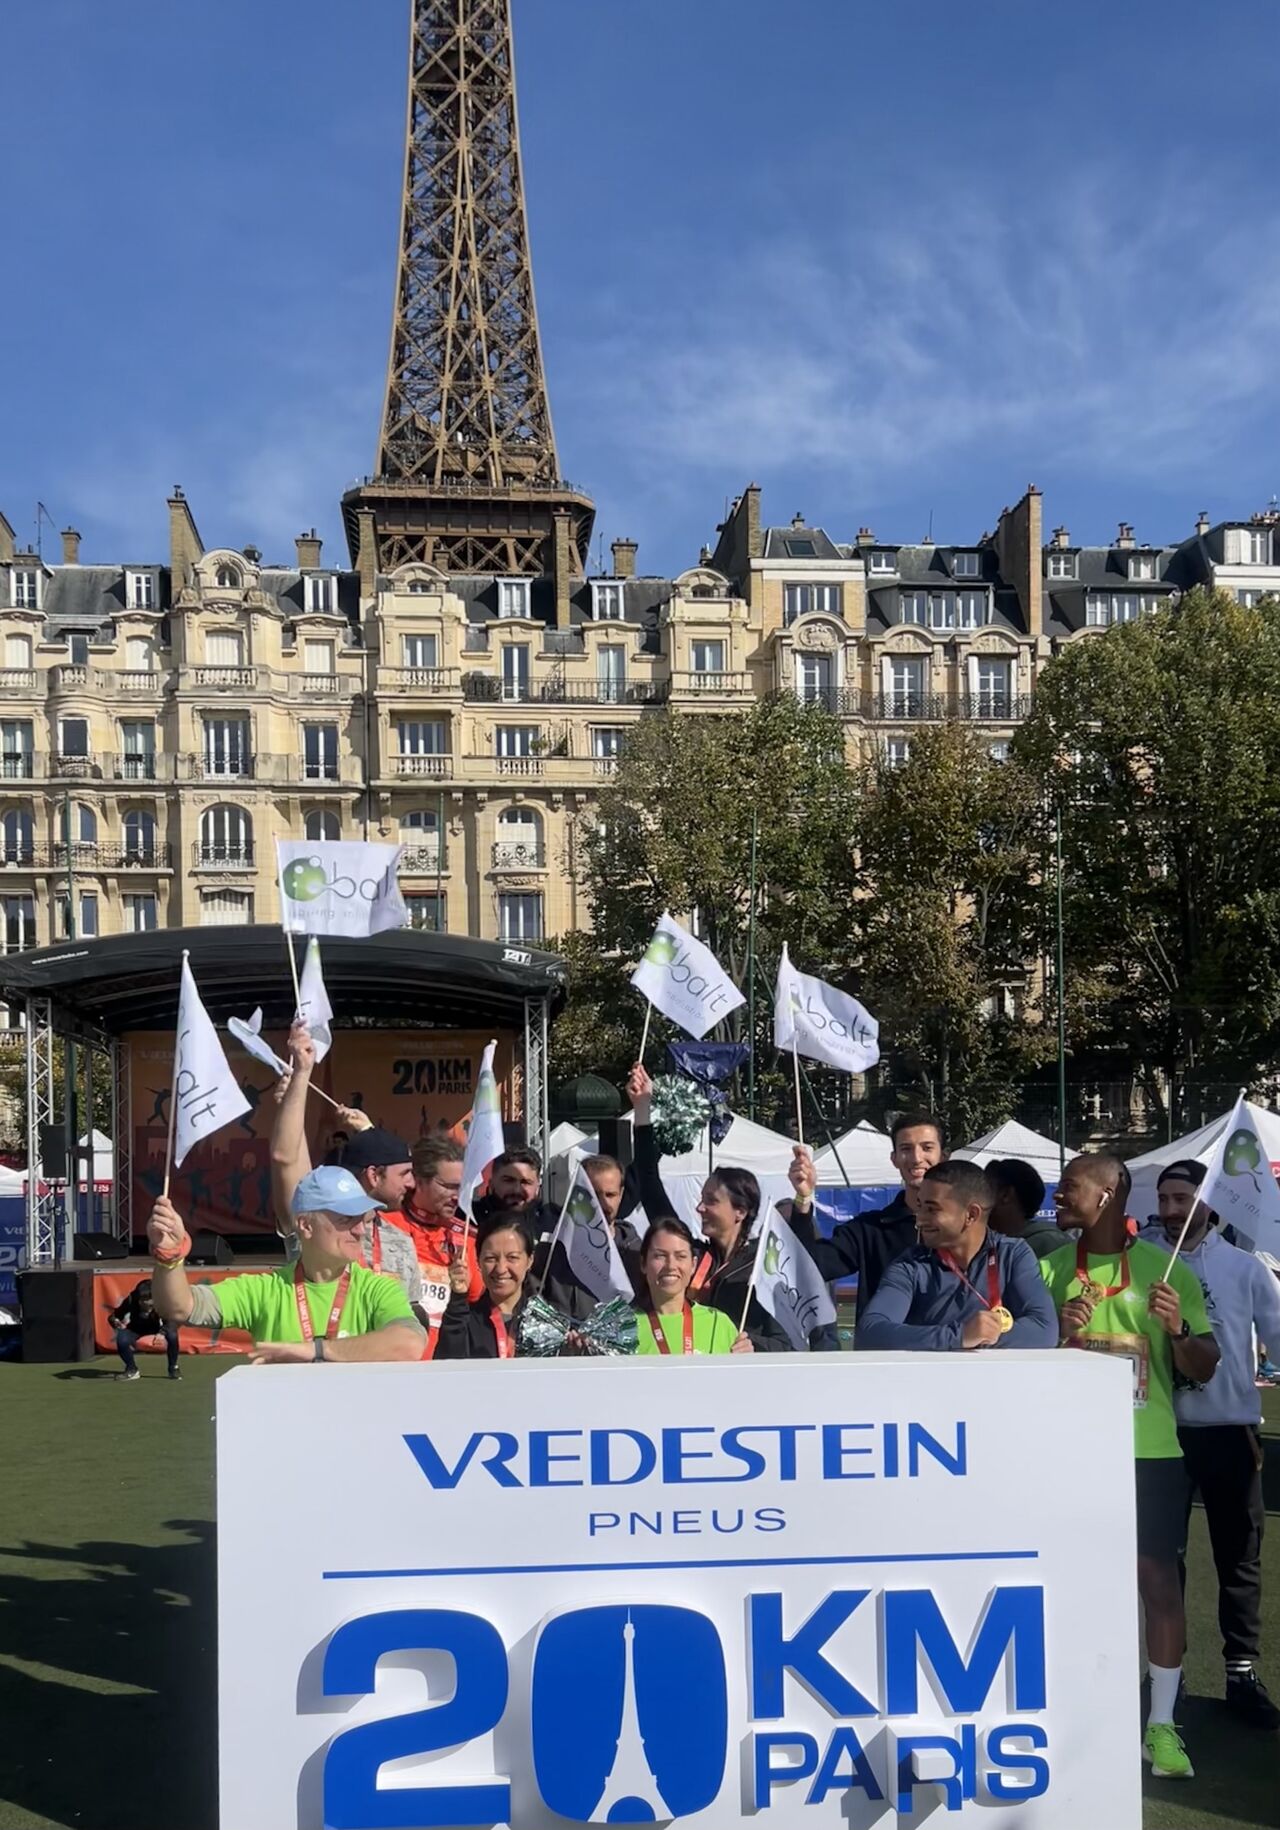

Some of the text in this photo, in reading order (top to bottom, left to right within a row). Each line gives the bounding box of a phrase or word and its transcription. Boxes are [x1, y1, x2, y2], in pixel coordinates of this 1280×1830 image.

[392, 1058, 472, 1095] 20 KM
[439, 1081, 473, 1095] PARIS
[402, 1420, 968, 1490] VREDESTEIN
[588, 1507, 787, 1537] PNEUS
[322, 1585, 1047, 1829] 20 KM
[754, 1723, 1050, 1813] PARIS
